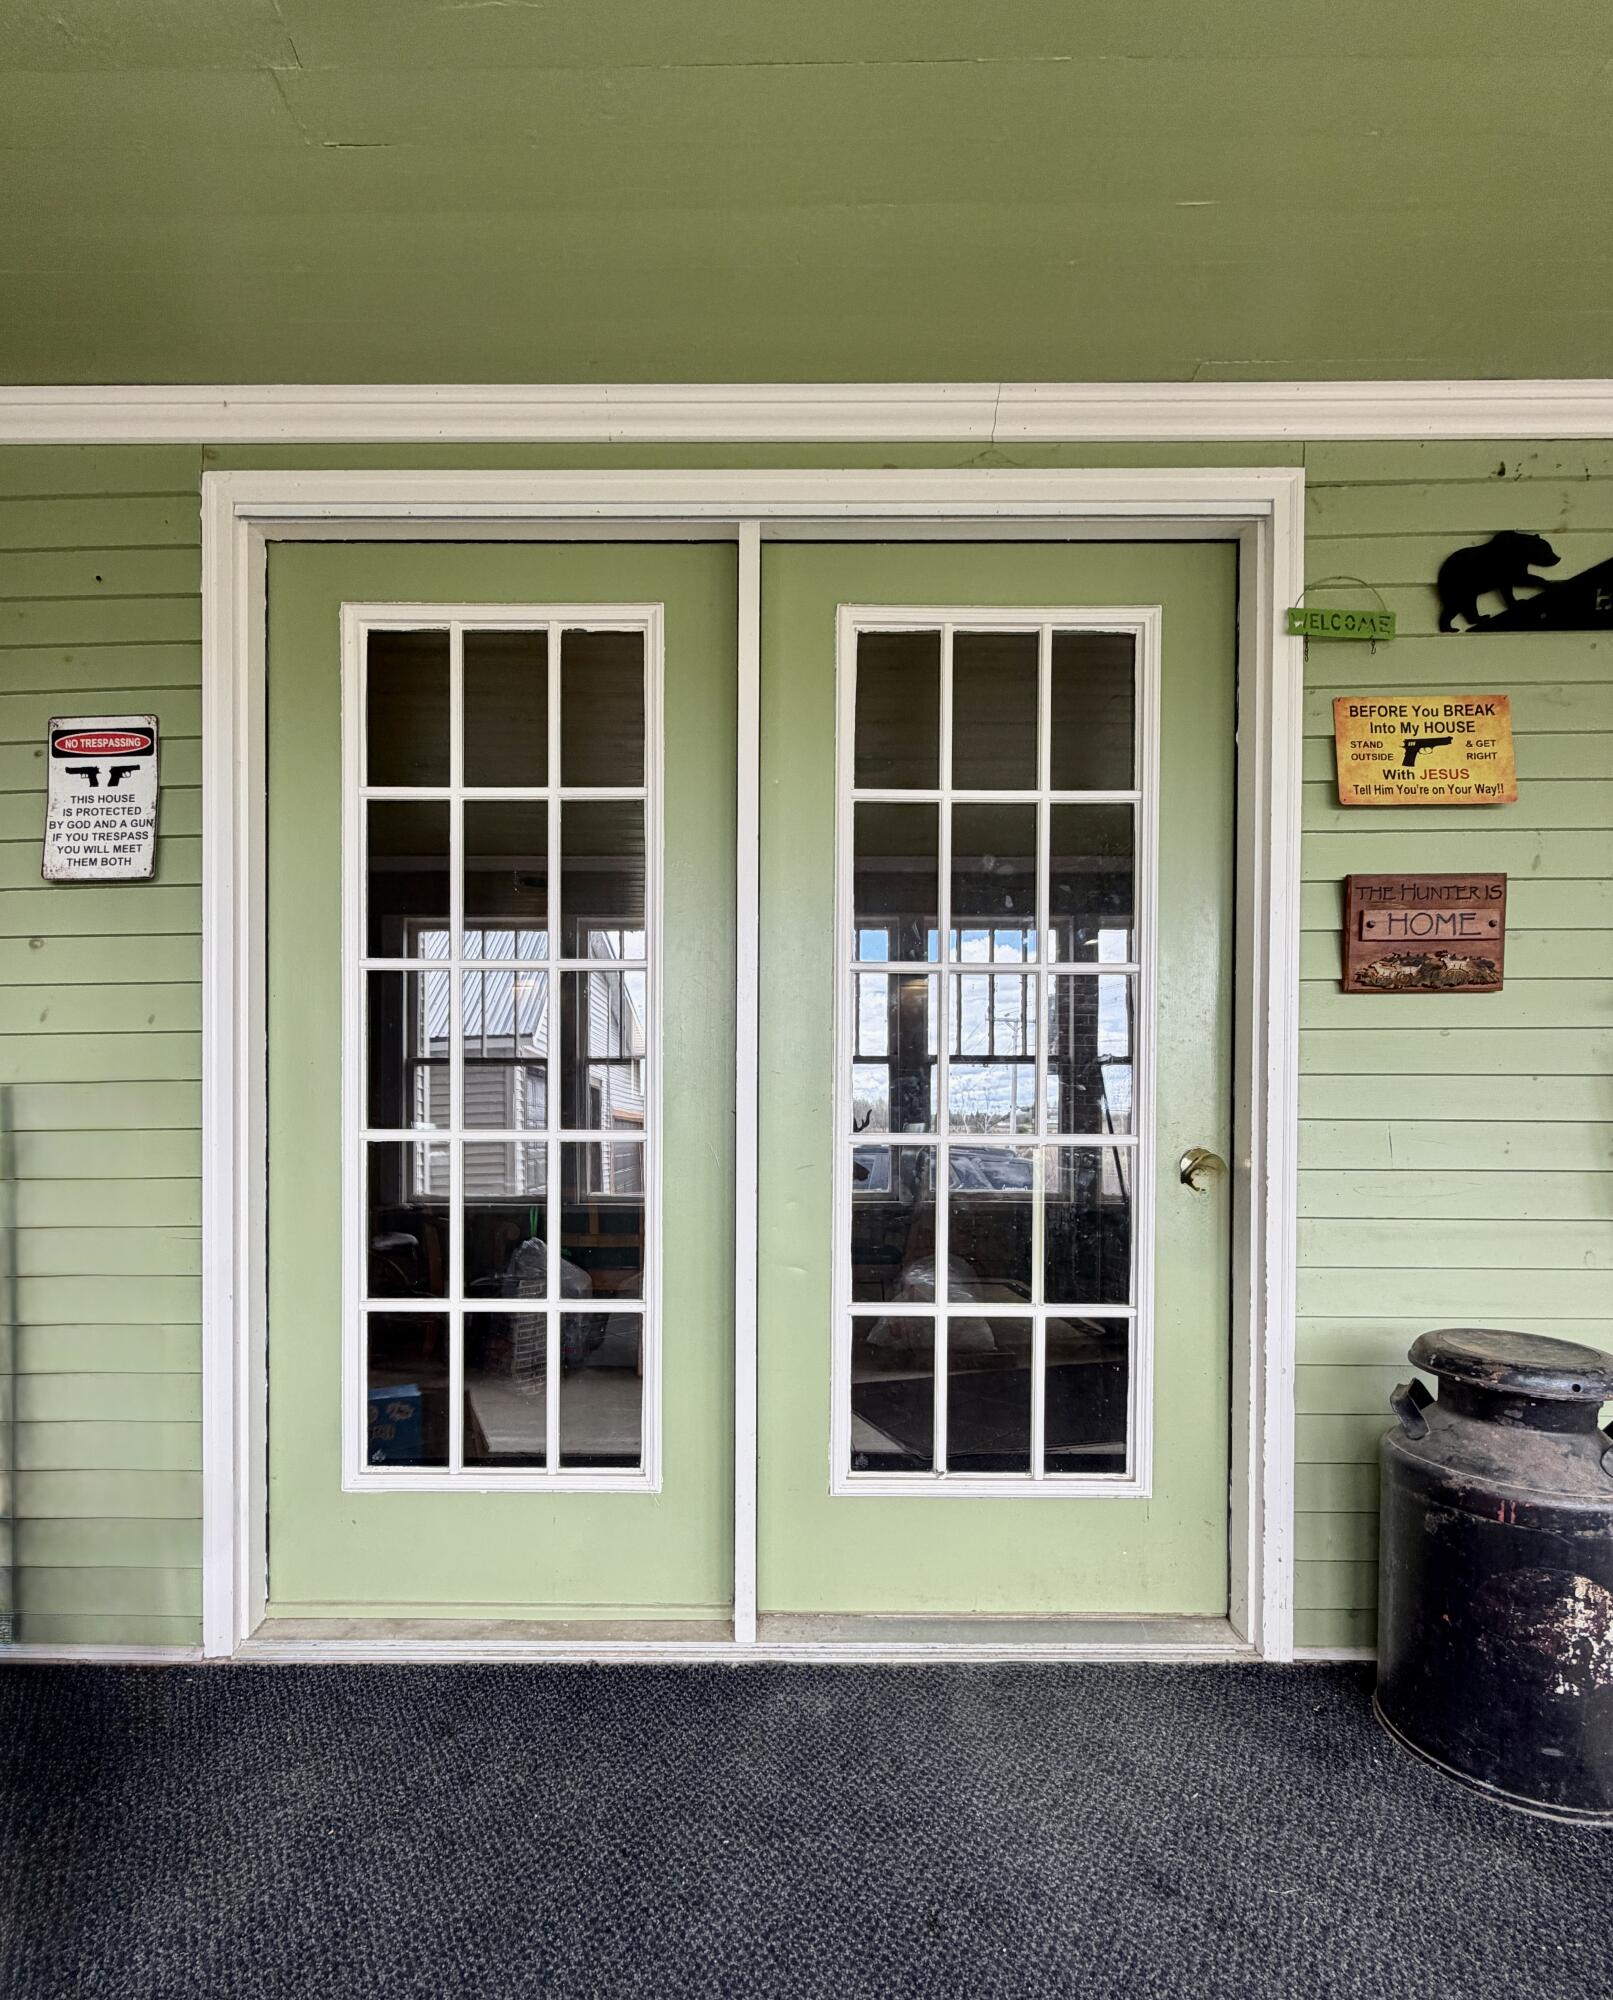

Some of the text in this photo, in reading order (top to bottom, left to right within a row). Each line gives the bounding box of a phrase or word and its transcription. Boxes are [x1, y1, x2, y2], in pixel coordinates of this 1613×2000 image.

[1291, 613, 1391, 634] WELCOME
[1349, 704, 1496, 717] BEFORE You BREAK
[1370, 721, 1476, 736] Into My HOUSE
[64, 738, 141, 748] NO TRESPASSING
[1465, 740, 1473, 748] &
[1351, 753, 1394, 761] OUTSIDE
[1466, 752, 1498, 760] RIGHT
[1383, 768, 1470, 780] With JESUS
[1353, 783, 1504, 797] Tell Him You're on Your Way!!
[70, 794, 135, 804] THIS HOUSE
[62, 806, 142, 816] IS PROTECTED
[49, 818, 154, 829] BY GOD AND A GUN
[52, 831, 149, 842] IF YOU TRESPASS
[57, 844, 143, 854] YOU WILL MEET
[67, 857, 132, 867] THEM BOTH
[1355, 883, 1503, 901] THE HUNTER IS
[1387, 912, 1482, 936] HOME
